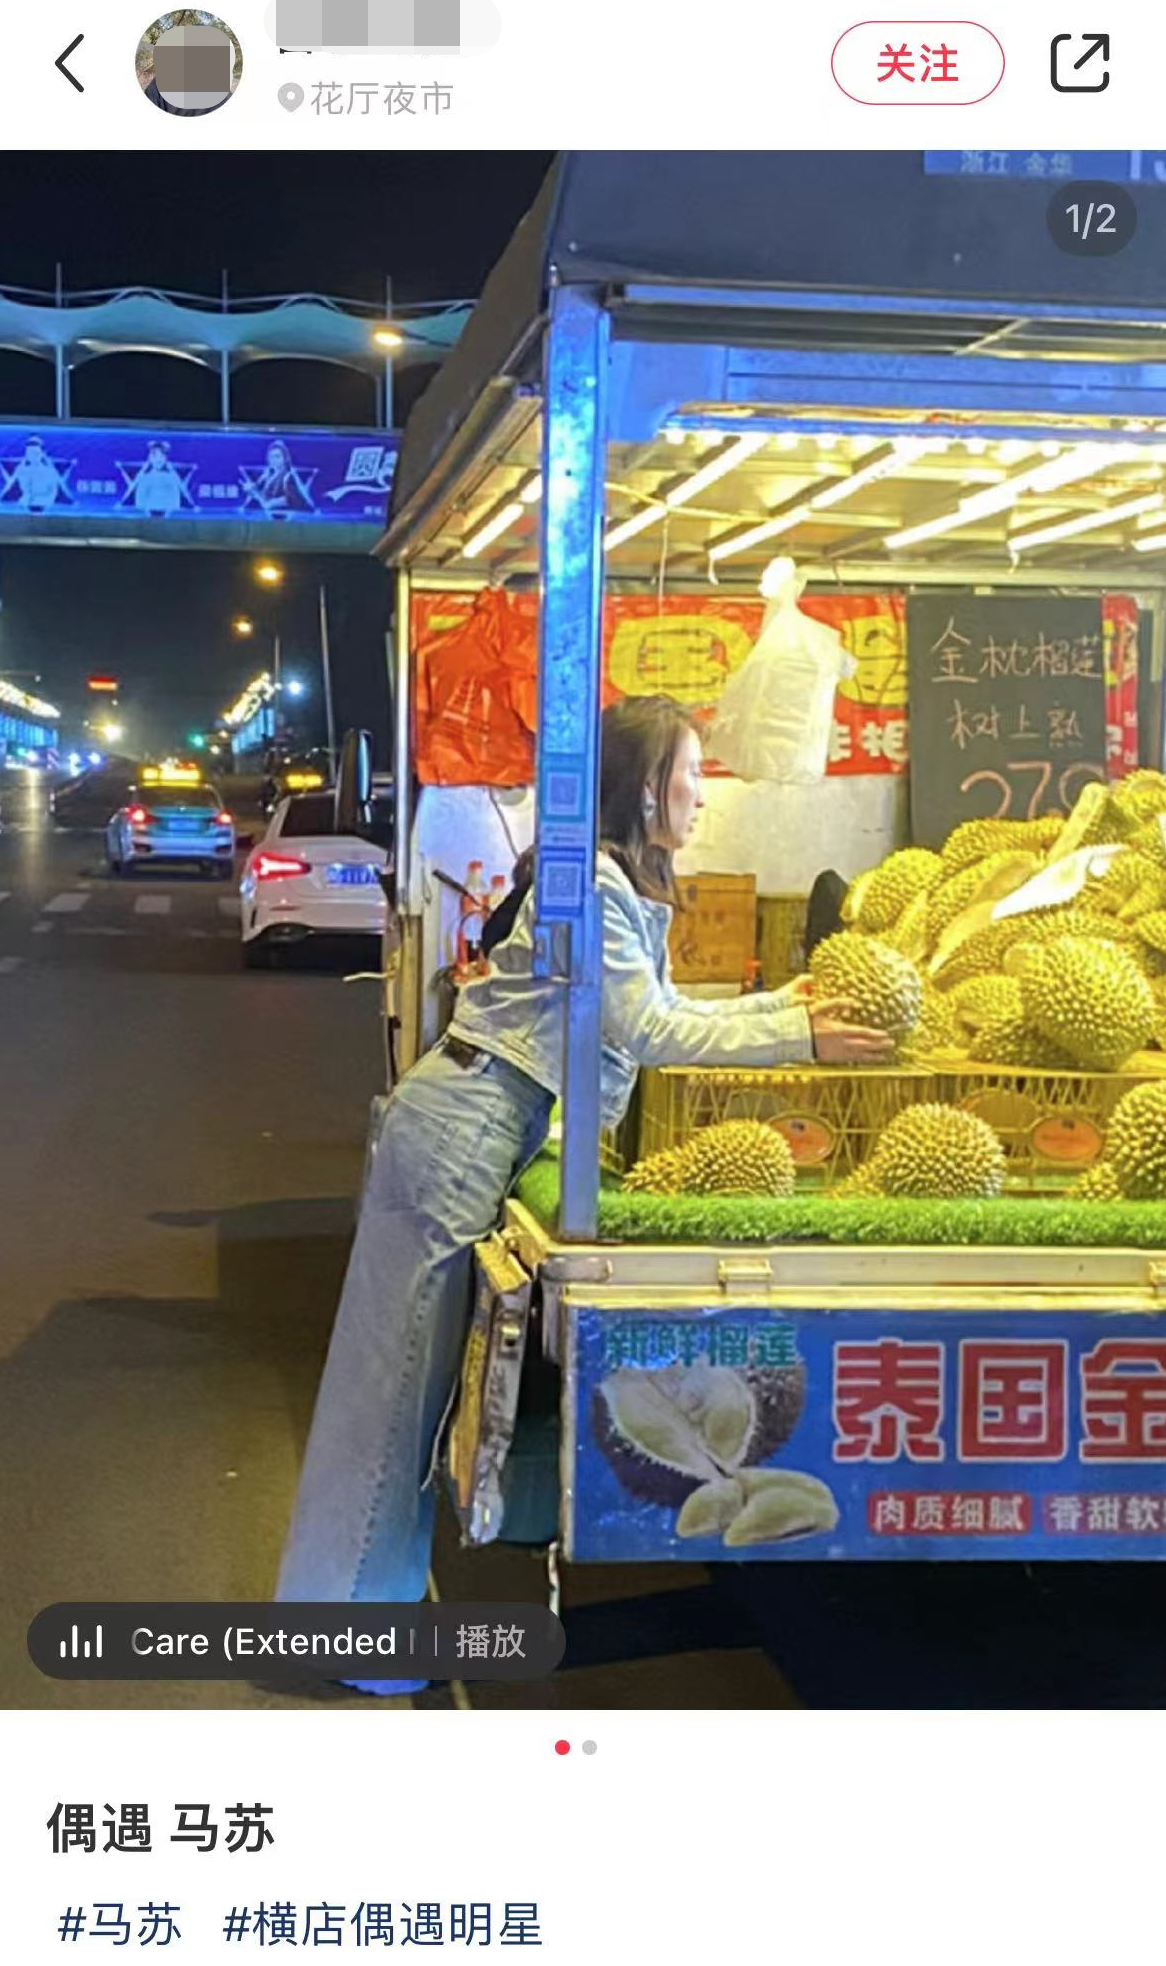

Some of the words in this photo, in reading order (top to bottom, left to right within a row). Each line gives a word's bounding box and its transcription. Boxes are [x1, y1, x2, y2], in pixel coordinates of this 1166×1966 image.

[605, 1320, 798, 1371] 新鲜榴莲
[832, 1337, 1166, 1462] 泰国金
[874, 1495, 1024, 1532] 肉质细腻
[1050, 1496, 1166, 1531] 香甜软
